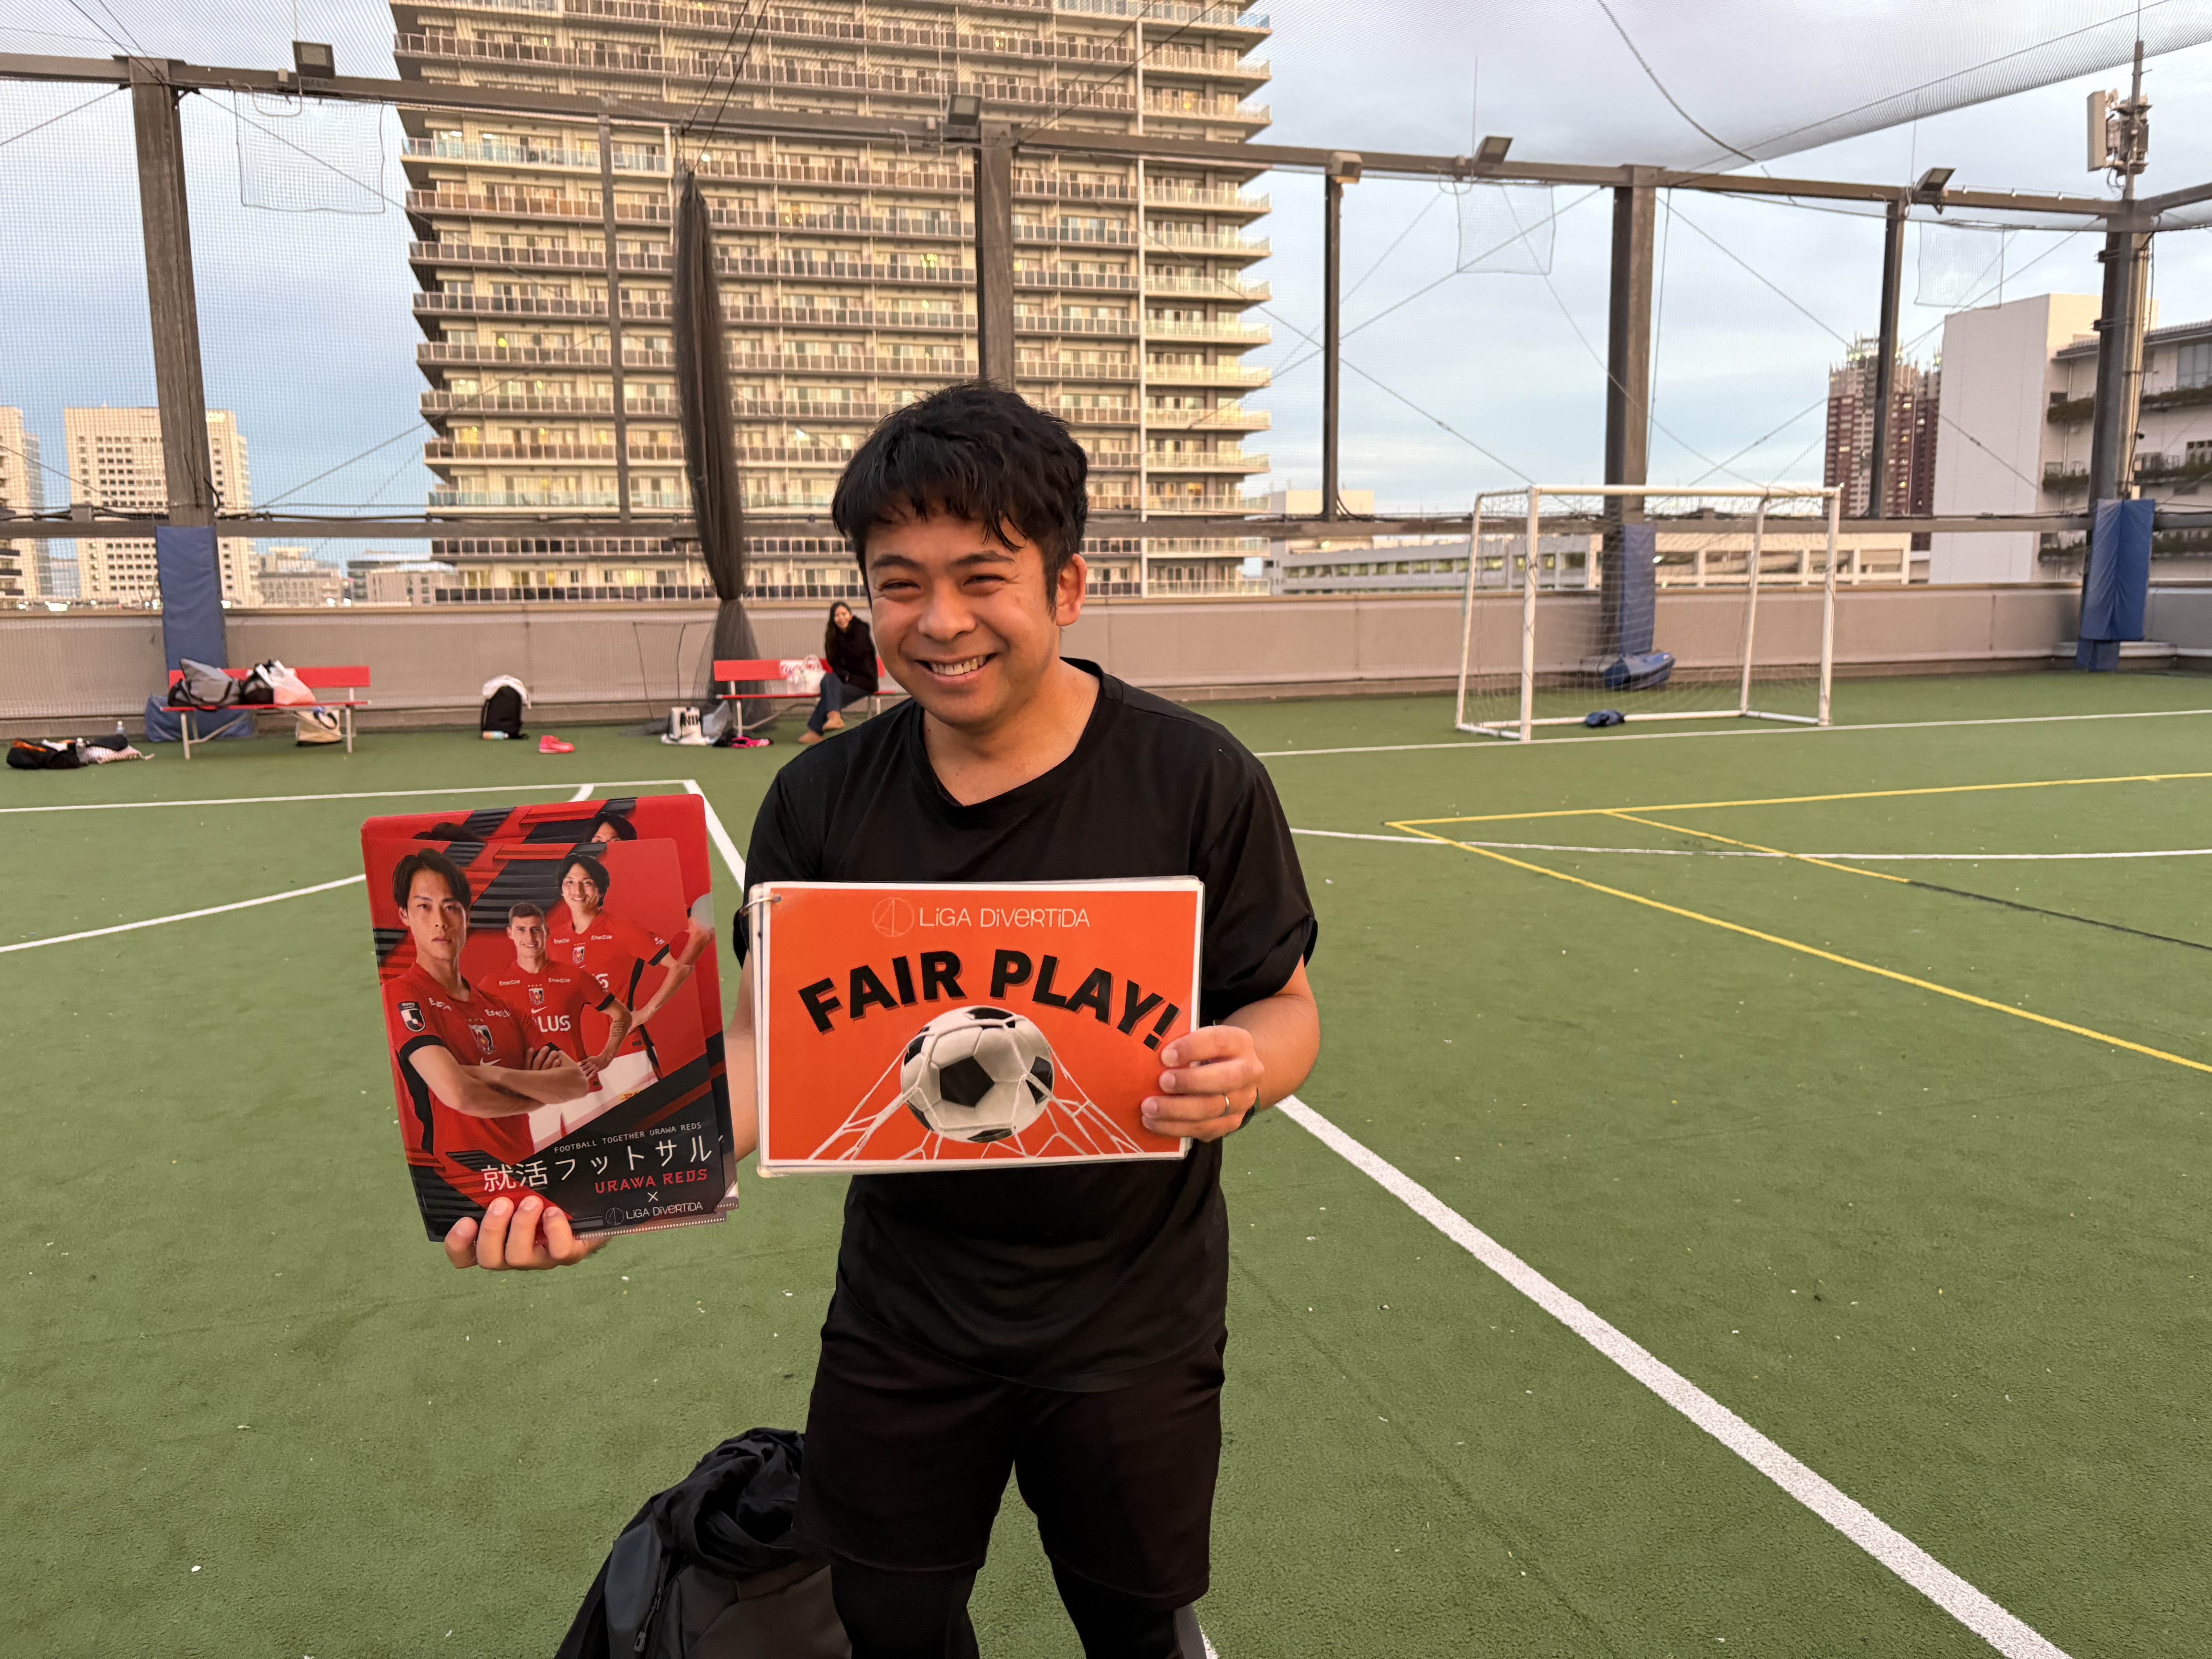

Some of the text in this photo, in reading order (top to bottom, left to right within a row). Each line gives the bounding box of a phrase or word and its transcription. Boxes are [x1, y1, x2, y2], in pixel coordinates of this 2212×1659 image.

[798, 949, 1181, 1051] FAIR PLAY!
[554, 1121, 702, 1153] FOOTBALL TOGETHER URAWA REDS
[481, 1135, 712, 1192] 就活フットサル
[595, 1168, 708, 1194] URAWA REDS
